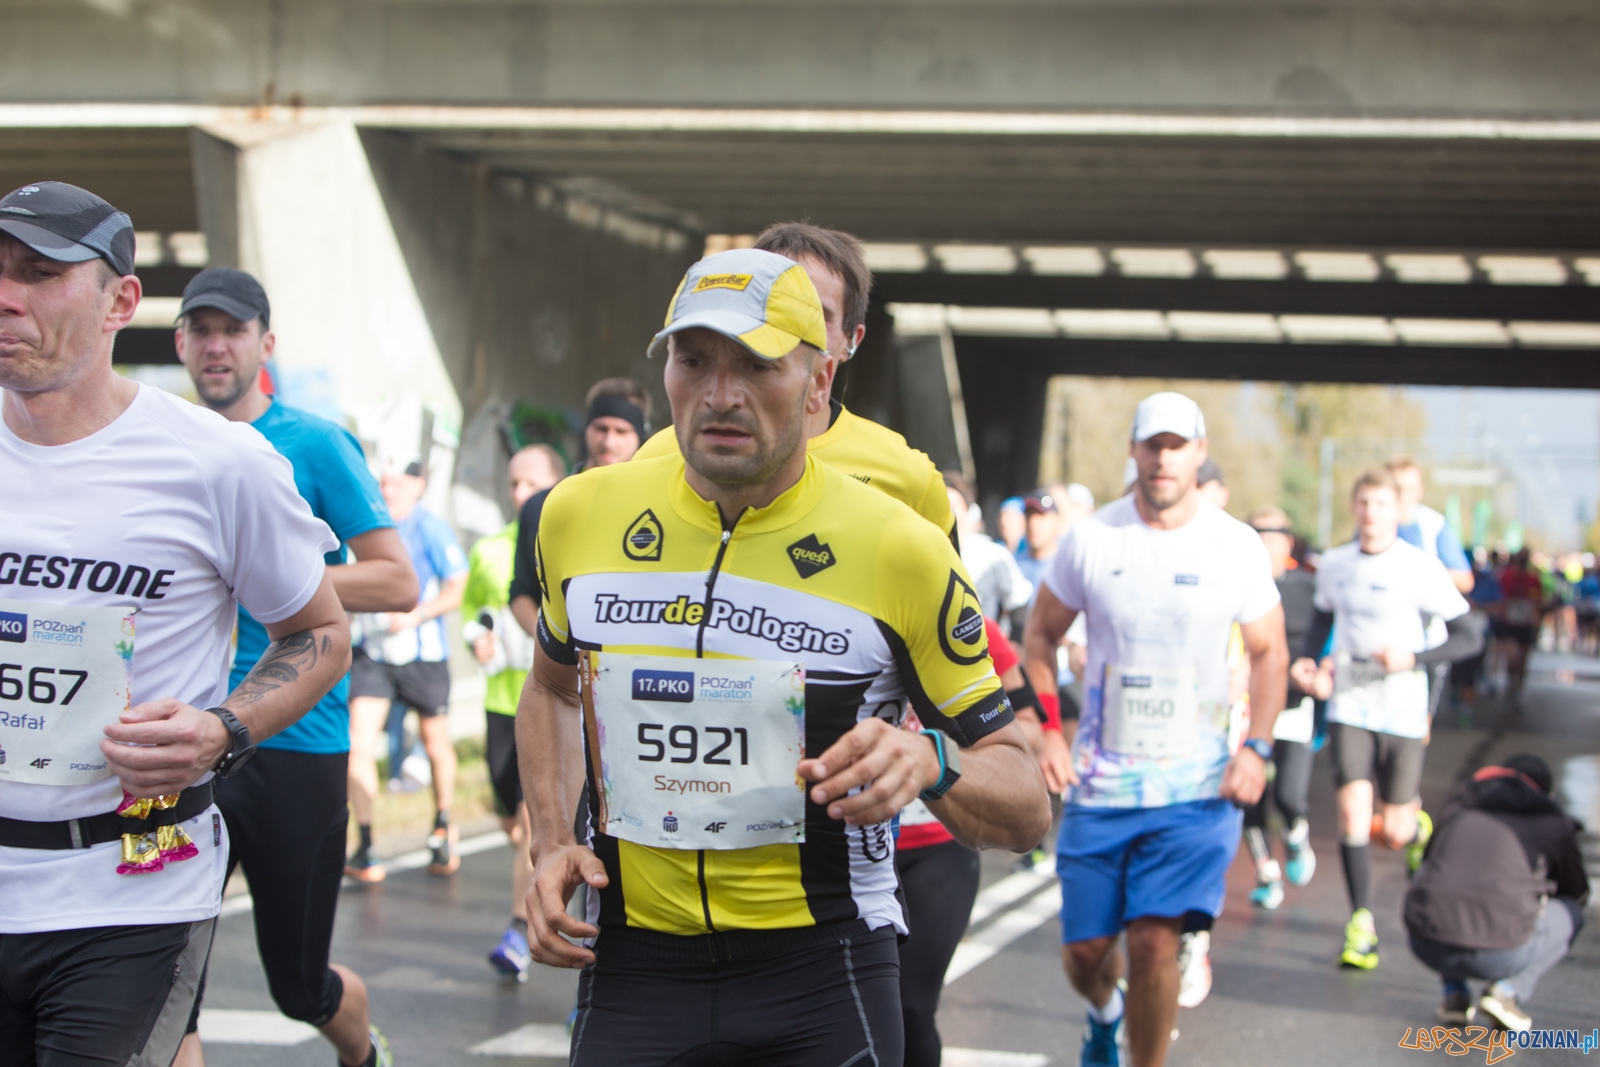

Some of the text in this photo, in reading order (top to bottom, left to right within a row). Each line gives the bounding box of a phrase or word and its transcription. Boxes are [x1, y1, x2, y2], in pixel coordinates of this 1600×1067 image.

[792, 547, 830, 565] quest
[0, 552, 176, 599] GESTONE
[33, 631, 83, 643] maraton
[700, 689, 752, 699] maraton
[1127, 699, 1175, 717] 1160
[0, 710, 45, 730] Rafał
[638, 723, 748, 765] 5921
[30, 758, 52, 769] 4F
[654, 775, 731, 795] Szymon
[704, 822, 727, 833] 4F
